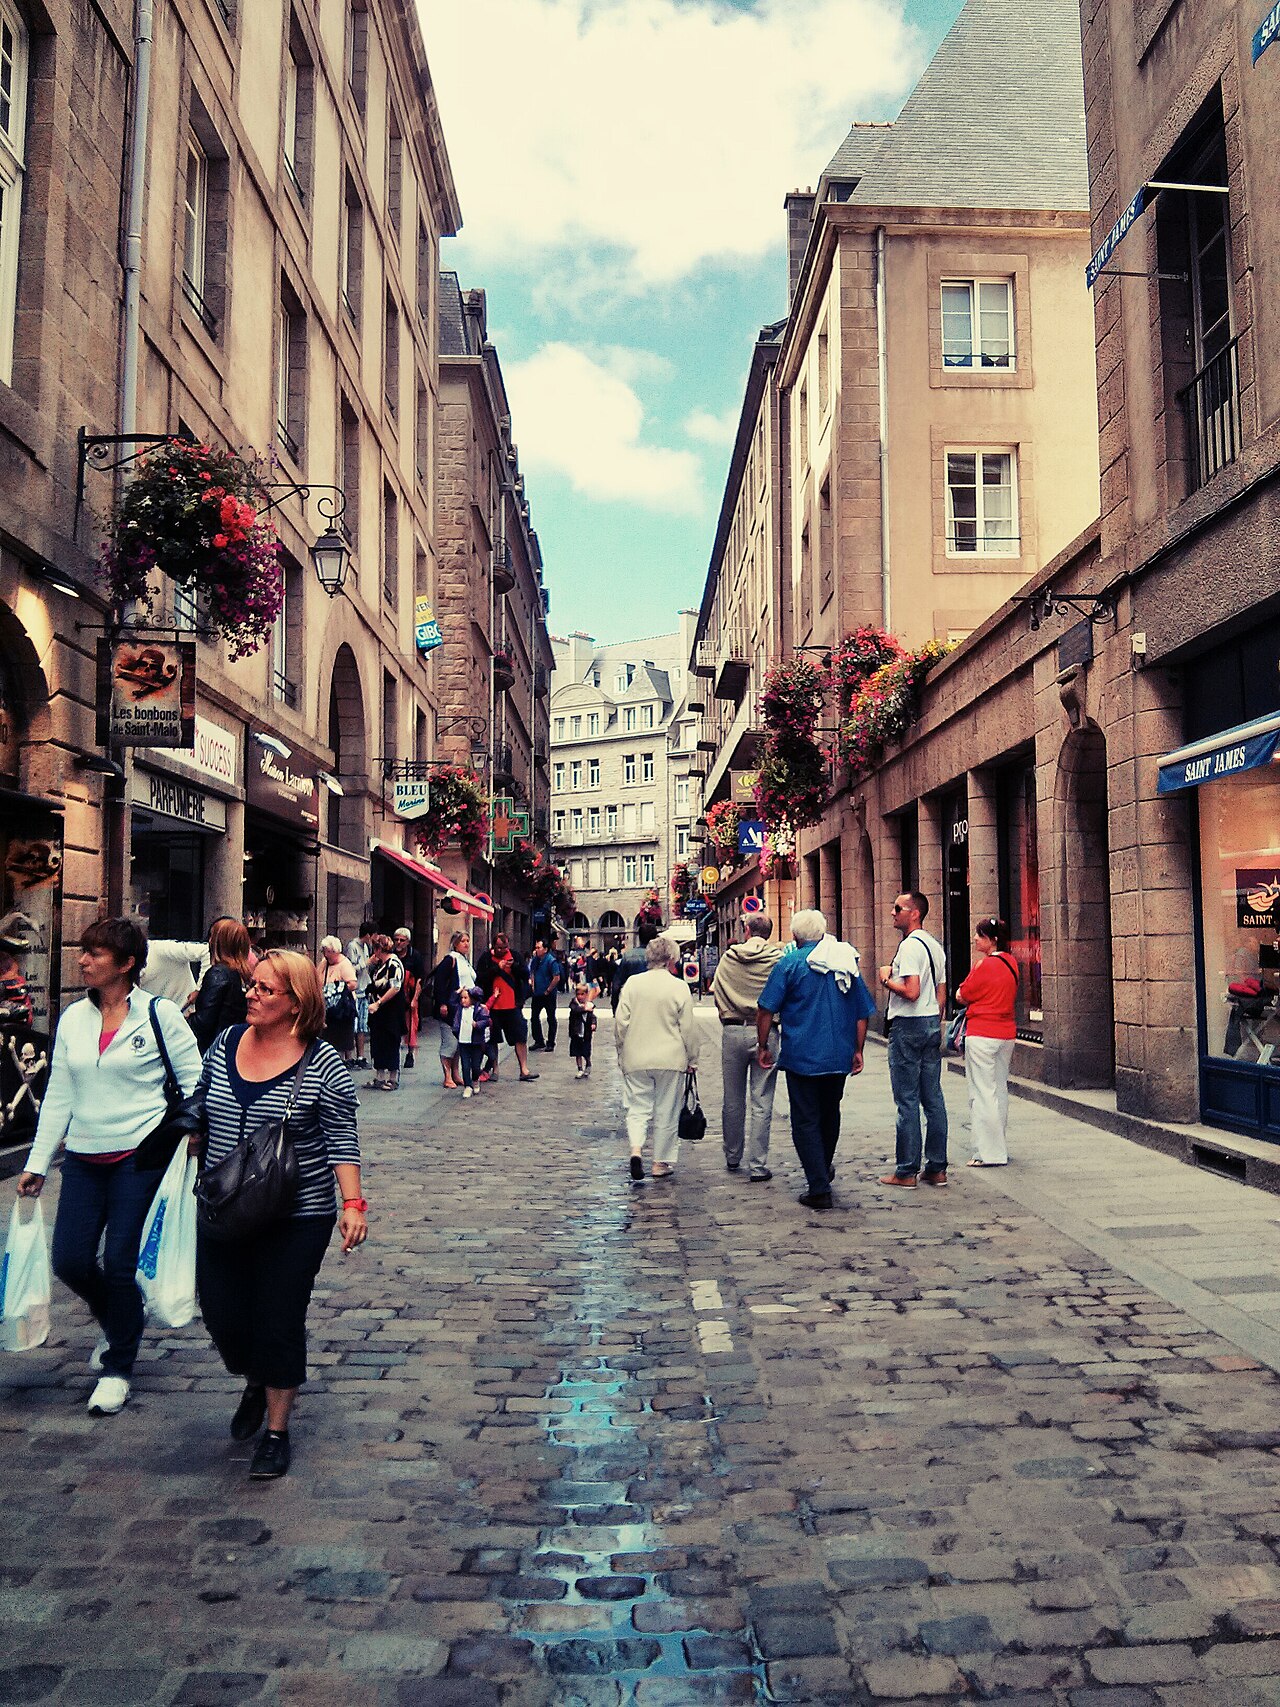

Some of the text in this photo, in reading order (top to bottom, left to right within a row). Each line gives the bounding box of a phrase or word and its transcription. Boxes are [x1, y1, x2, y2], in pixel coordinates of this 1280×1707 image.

[1090, 199, 1136, 280] SAINT JAMES
[114, 705, 178, 721] Les bonbons
[114, 720, 178, 737] de Saint-Malo
[200, 734, 232, 777] SUCCESS
[1184, 746, 1246, 783] SAINT JAMES
[396, 784, 427, 796] BLEU
[149, 777, 206, 823] PARFUMERIE
[397, 797, 426, 811] Marine
[706, 869, 714, 880] C
[1243, 914, 1273, 925] SAINT
